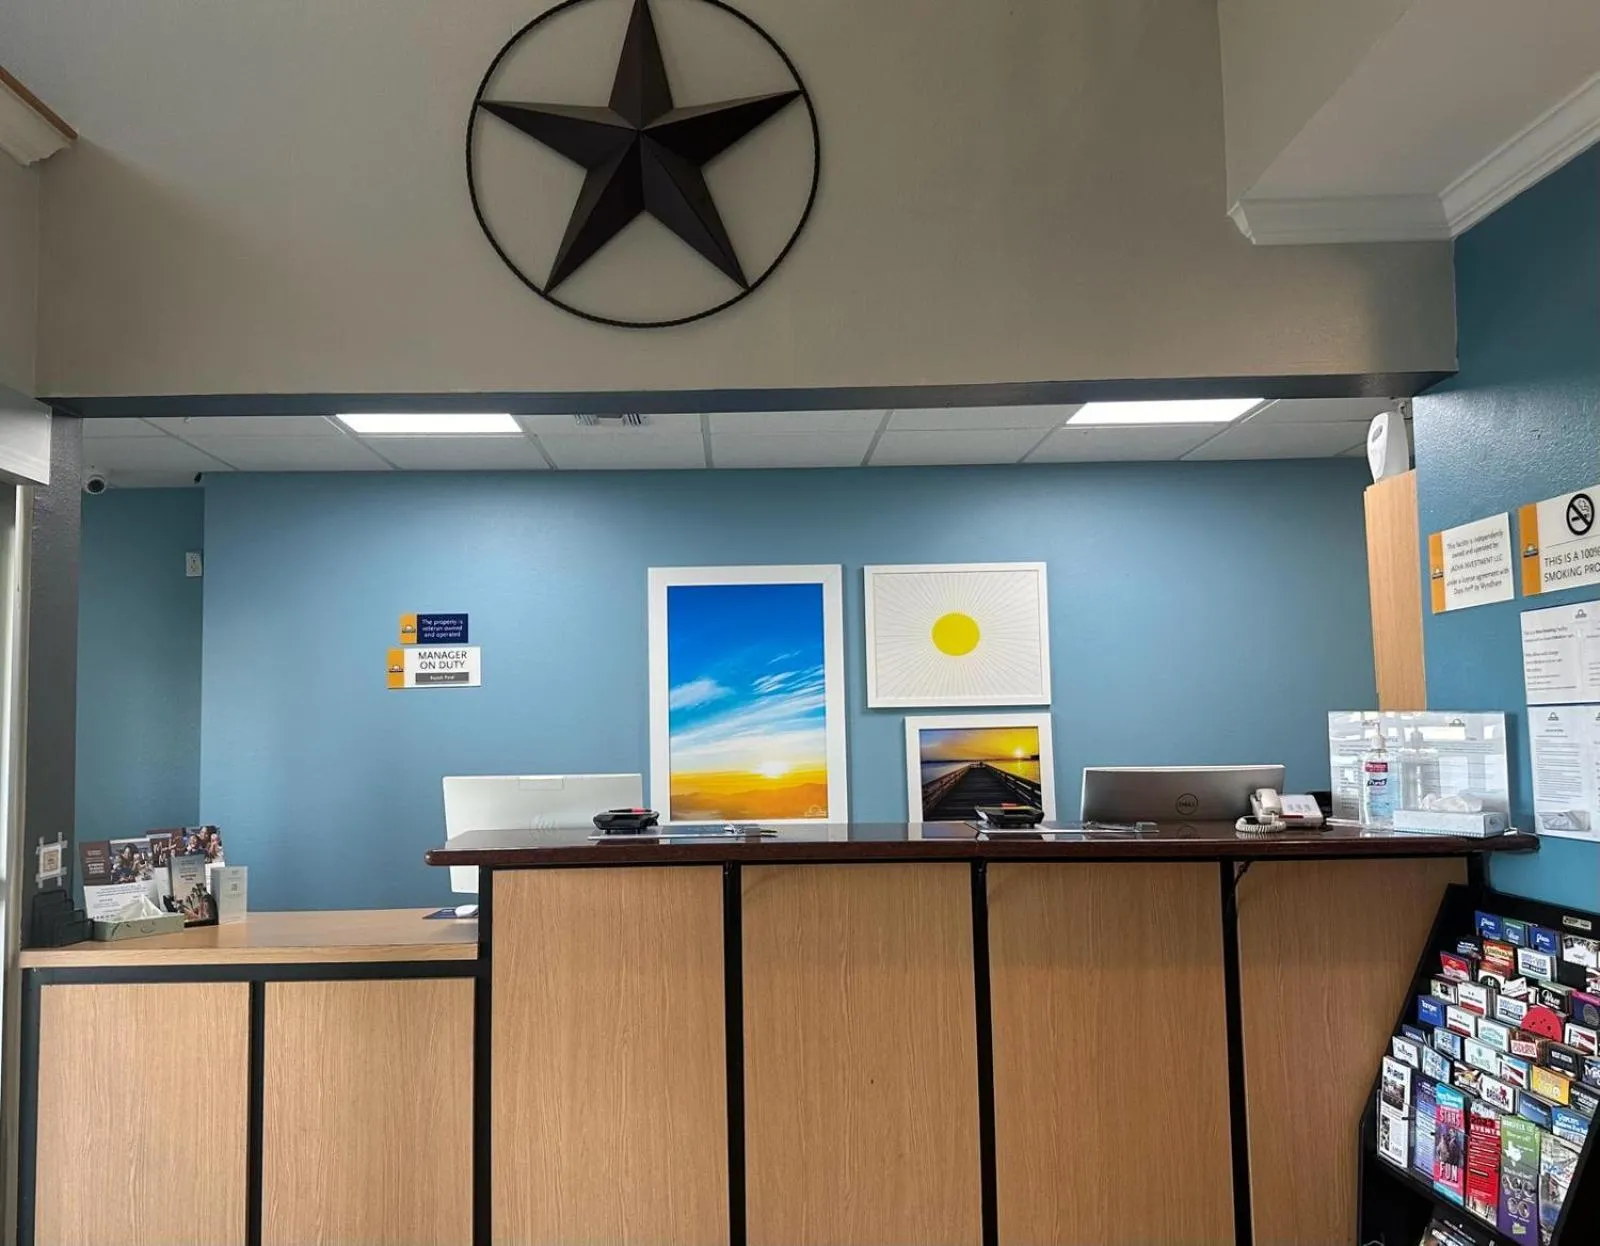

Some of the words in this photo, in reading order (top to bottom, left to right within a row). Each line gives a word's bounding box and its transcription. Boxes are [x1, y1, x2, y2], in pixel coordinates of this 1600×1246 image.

[1473, 528, 1504, 543] independently
[1464, 556, 1493, 569] INVESTMENT
[1544, 555, 1562, 567] THIS
[1564, 552, 1572, 563] IS
[1573, 550, 1579, 561] A
[1544, 566, 1582, 583] SMOKING
[434, 619, 457, 627] property
[436, 631, 461, 639] operated
[418, 650, 467, 660] MANAGER
[420, 660, 436, 670] ON
[439, 660, 466, 669] DUTY
[1440, 1162, 1458, 1182] FUN
